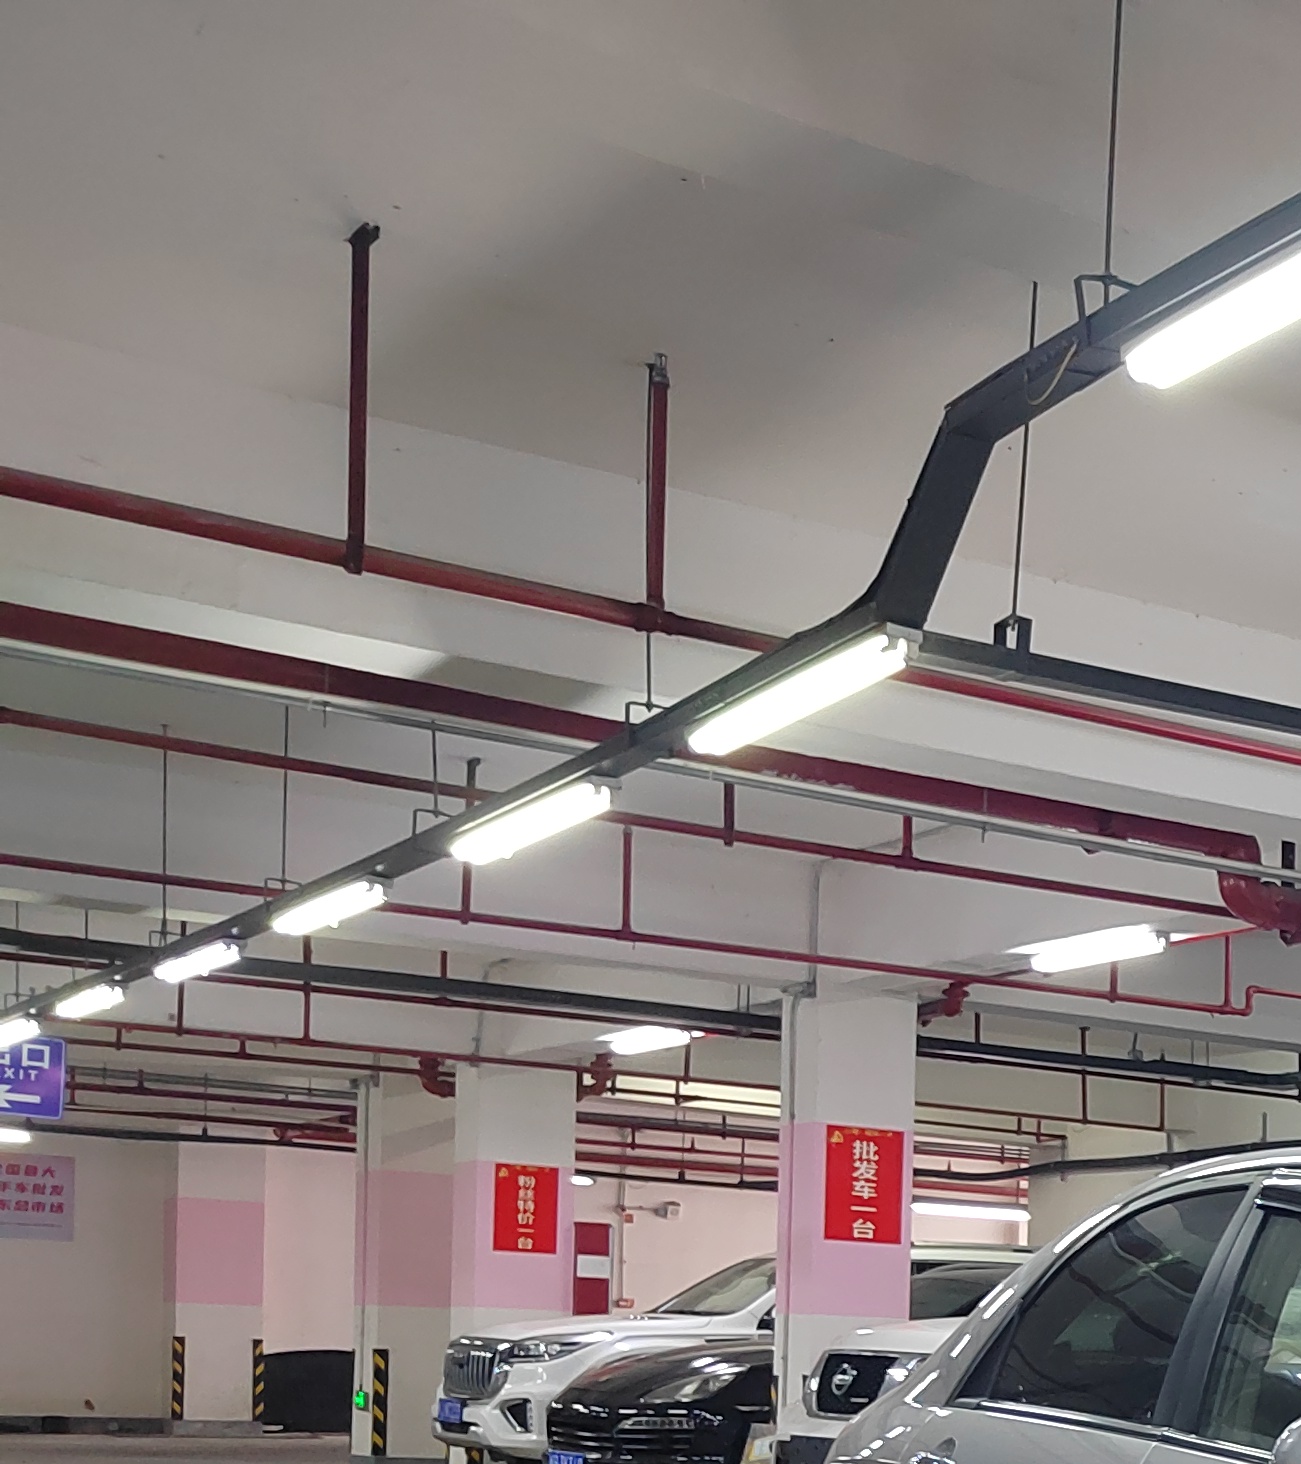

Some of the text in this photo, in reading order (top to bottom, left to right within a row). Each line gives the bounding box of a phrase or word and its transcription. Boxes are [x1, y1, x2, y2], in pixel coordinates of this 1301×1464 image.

[0, 1044, 50, 1070] 口
[0, 1067, 39, 1082] XIT
[850, 1140, 879, 1239] 批发车一台
